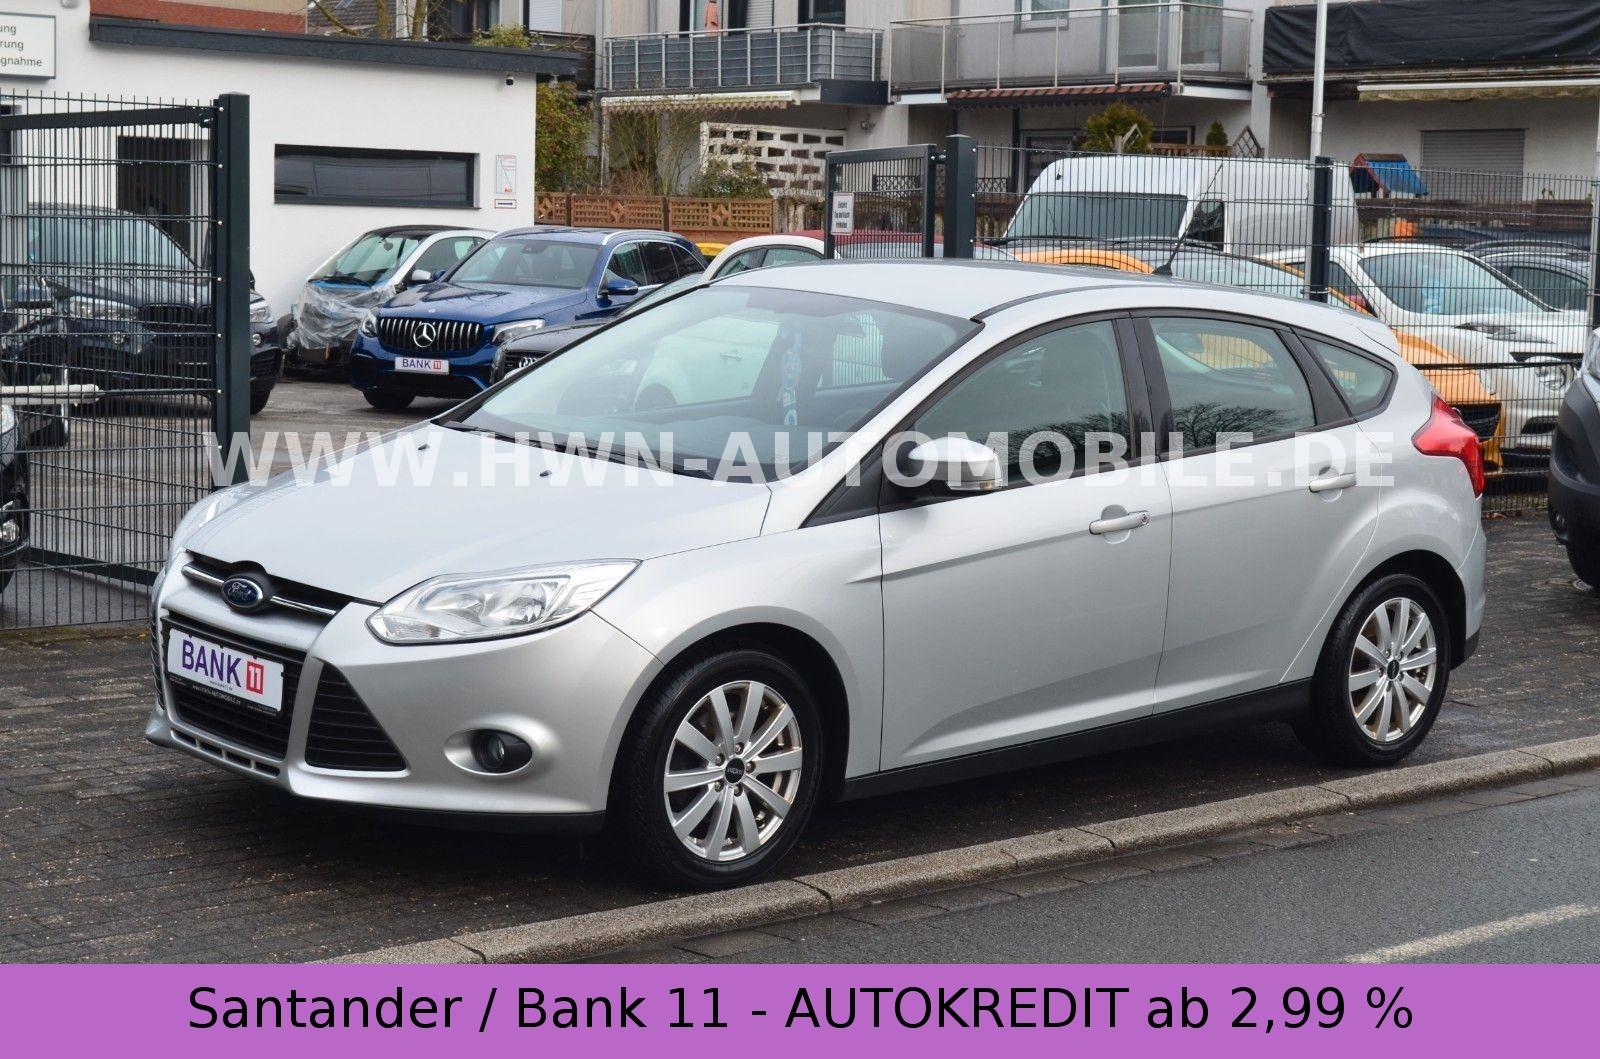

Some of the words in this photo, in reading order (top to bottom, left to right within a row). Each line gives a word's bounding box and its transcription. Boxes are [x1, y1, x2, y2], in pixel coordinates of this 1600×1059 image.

[402, 358, 431, 369] BANK
[228, 582, 251, 600] Ford
[182, 639, 242, 688] BANK
[247, 662, 263, 693] 11
